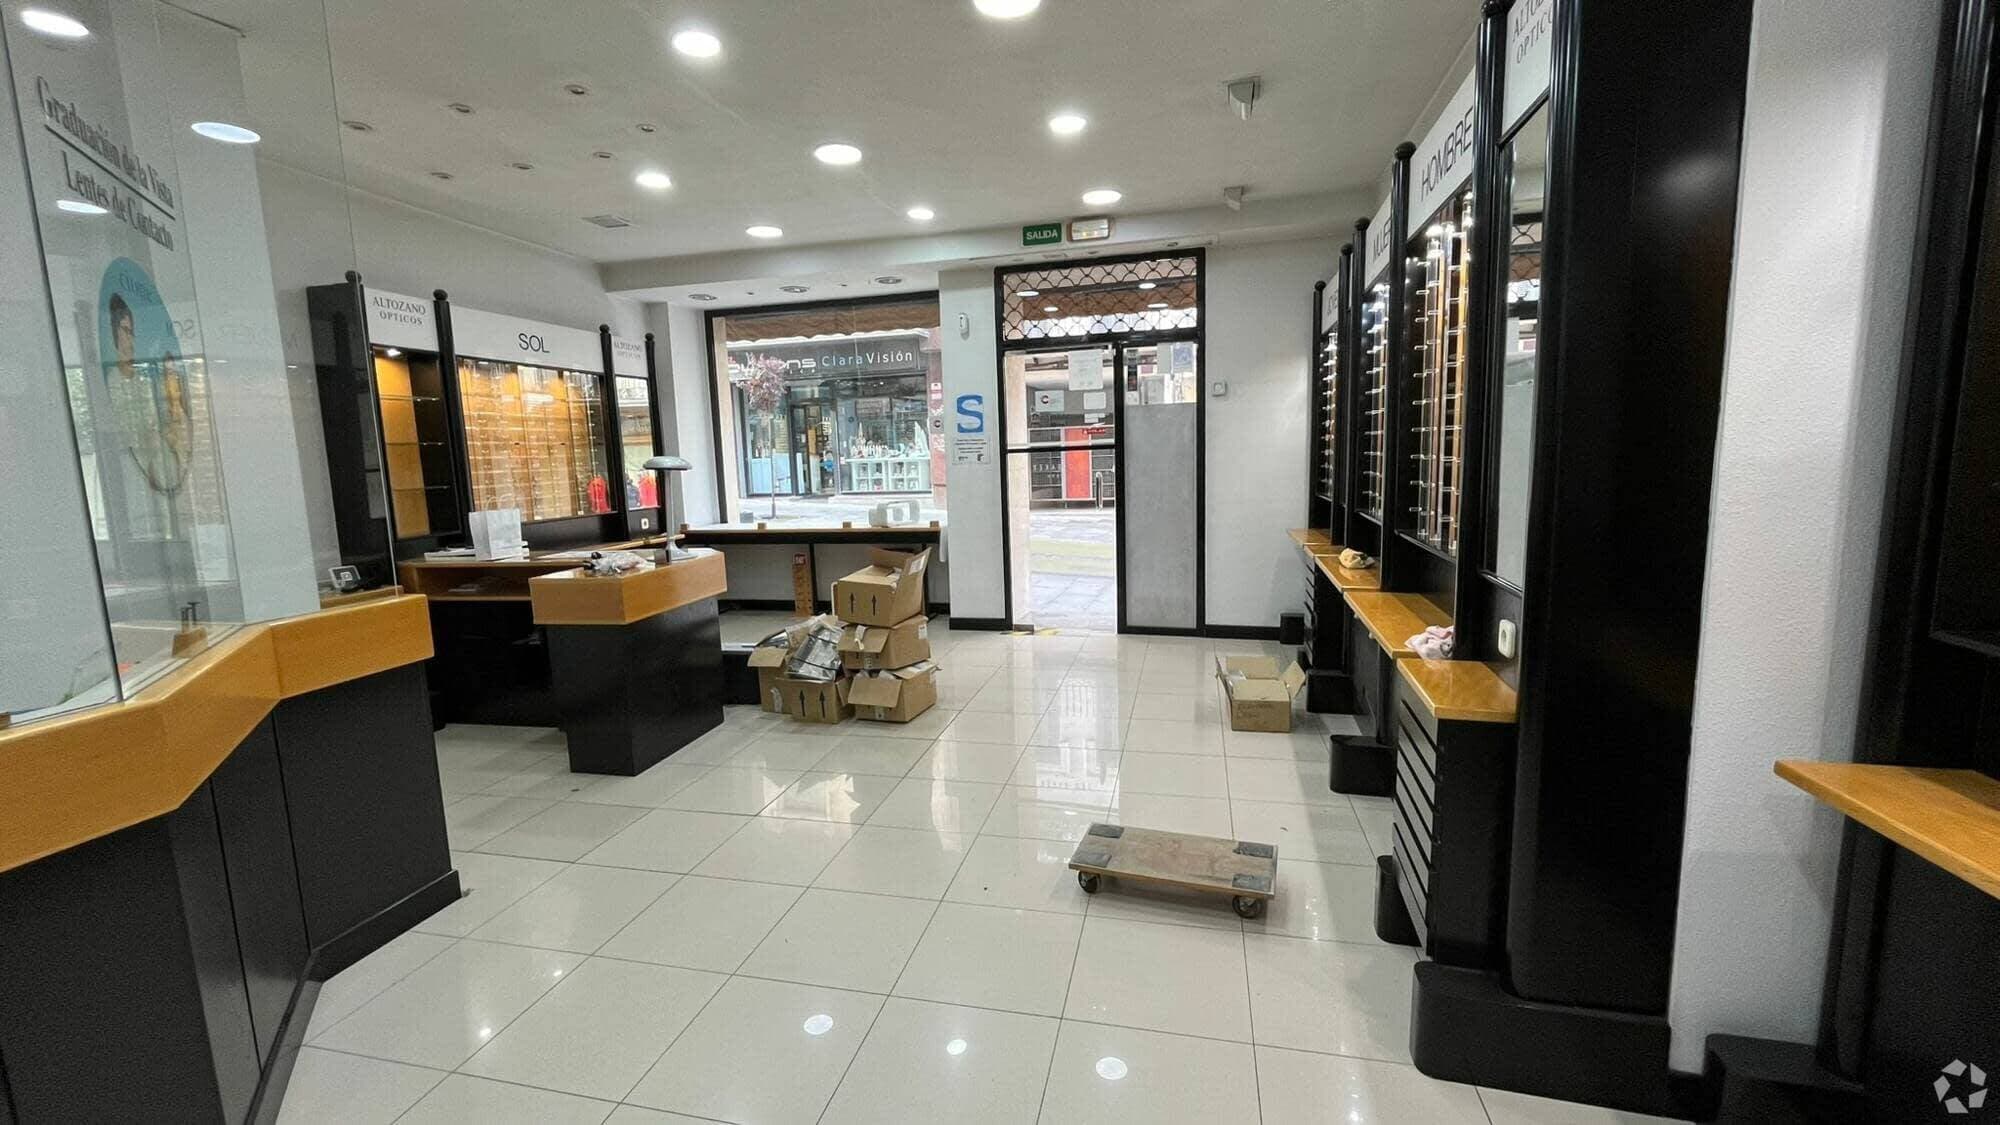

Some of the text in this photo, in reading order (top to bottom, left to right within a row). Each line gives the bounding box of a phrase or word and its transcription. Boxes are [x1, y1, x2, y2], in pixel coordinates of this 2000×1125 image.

[1420, 104, 1474, 201] HOMBRE
[122, 145, 136, 182] de
[147, 163, 174, 210] Vista
[62, 150, 174, 251] Lentes de Contacto
[1026, 229, 1058, 241] SALIDA
[372, 296, 426, 315] ALTOZANO
[379, 310, 423, 325] OPTICOS
[518, 333, 551, 354] SOL
[822, 354, 863, 367] Clara
[866, 349, 913, 365] Visión
[956, 394, 984, 433] S
